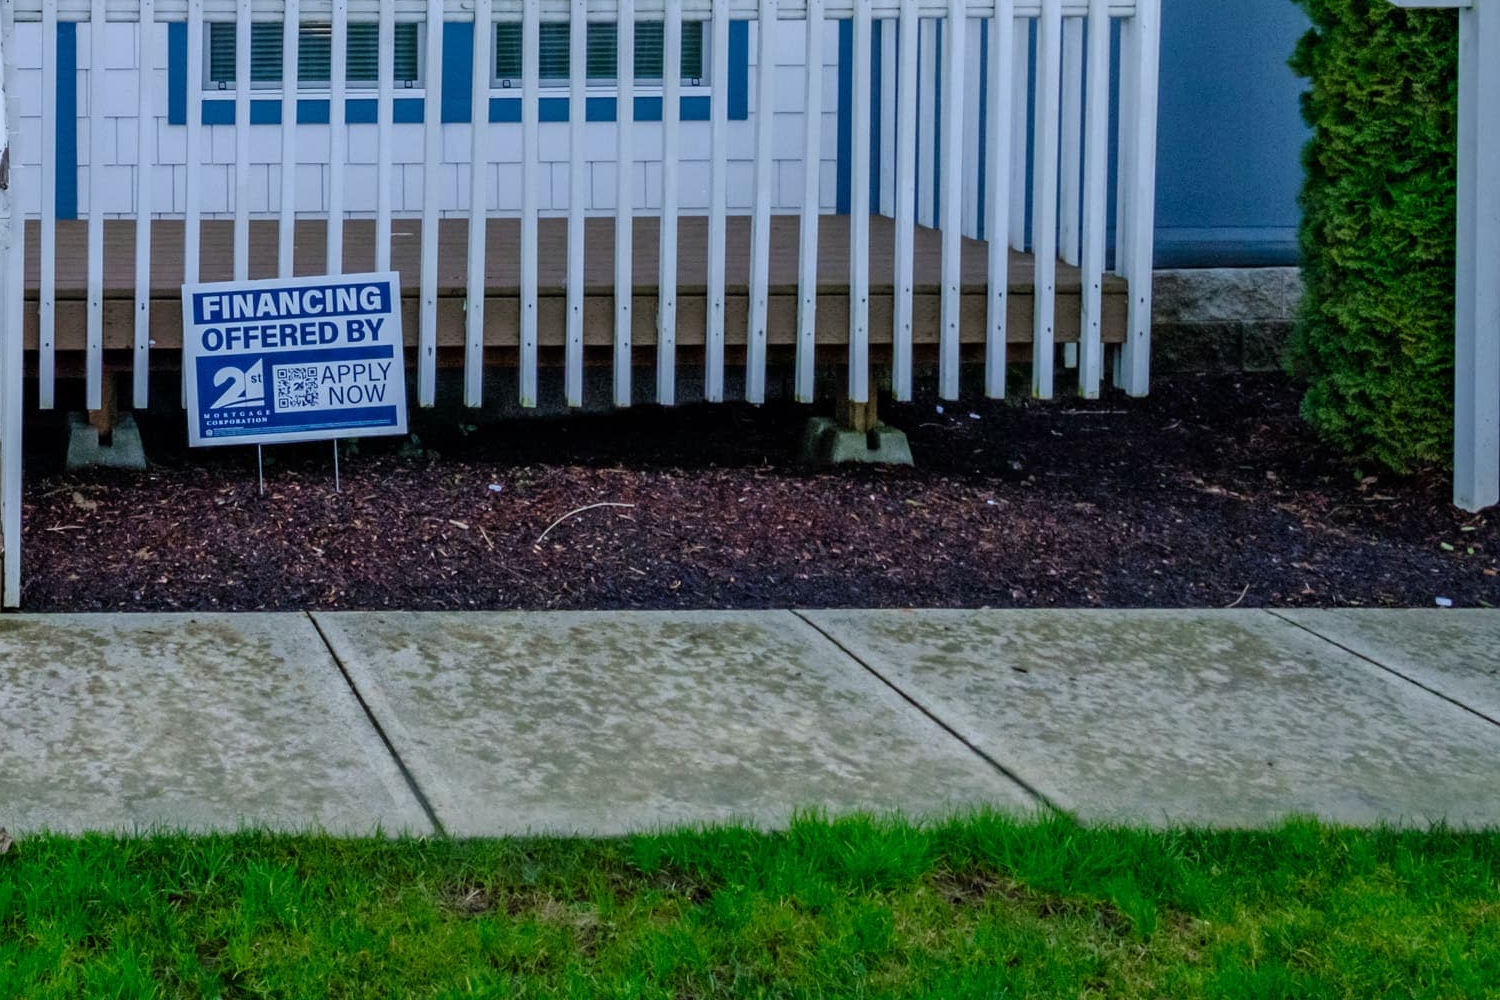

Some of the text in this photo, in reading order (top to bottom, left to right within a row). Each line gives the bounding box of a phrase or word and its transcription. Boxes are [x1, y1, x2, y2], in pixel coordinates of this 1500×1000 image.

[202, 286, 382, 320] FINANCING
[202, 318, 384, 352] OFFERED BY
[321, 361, 392, 385] APPLY
[329, 383, 386, 405] NOW
[203, 410, 271, 419] MORTGAGE
[206, 417, 268, 426] CORPORATION
